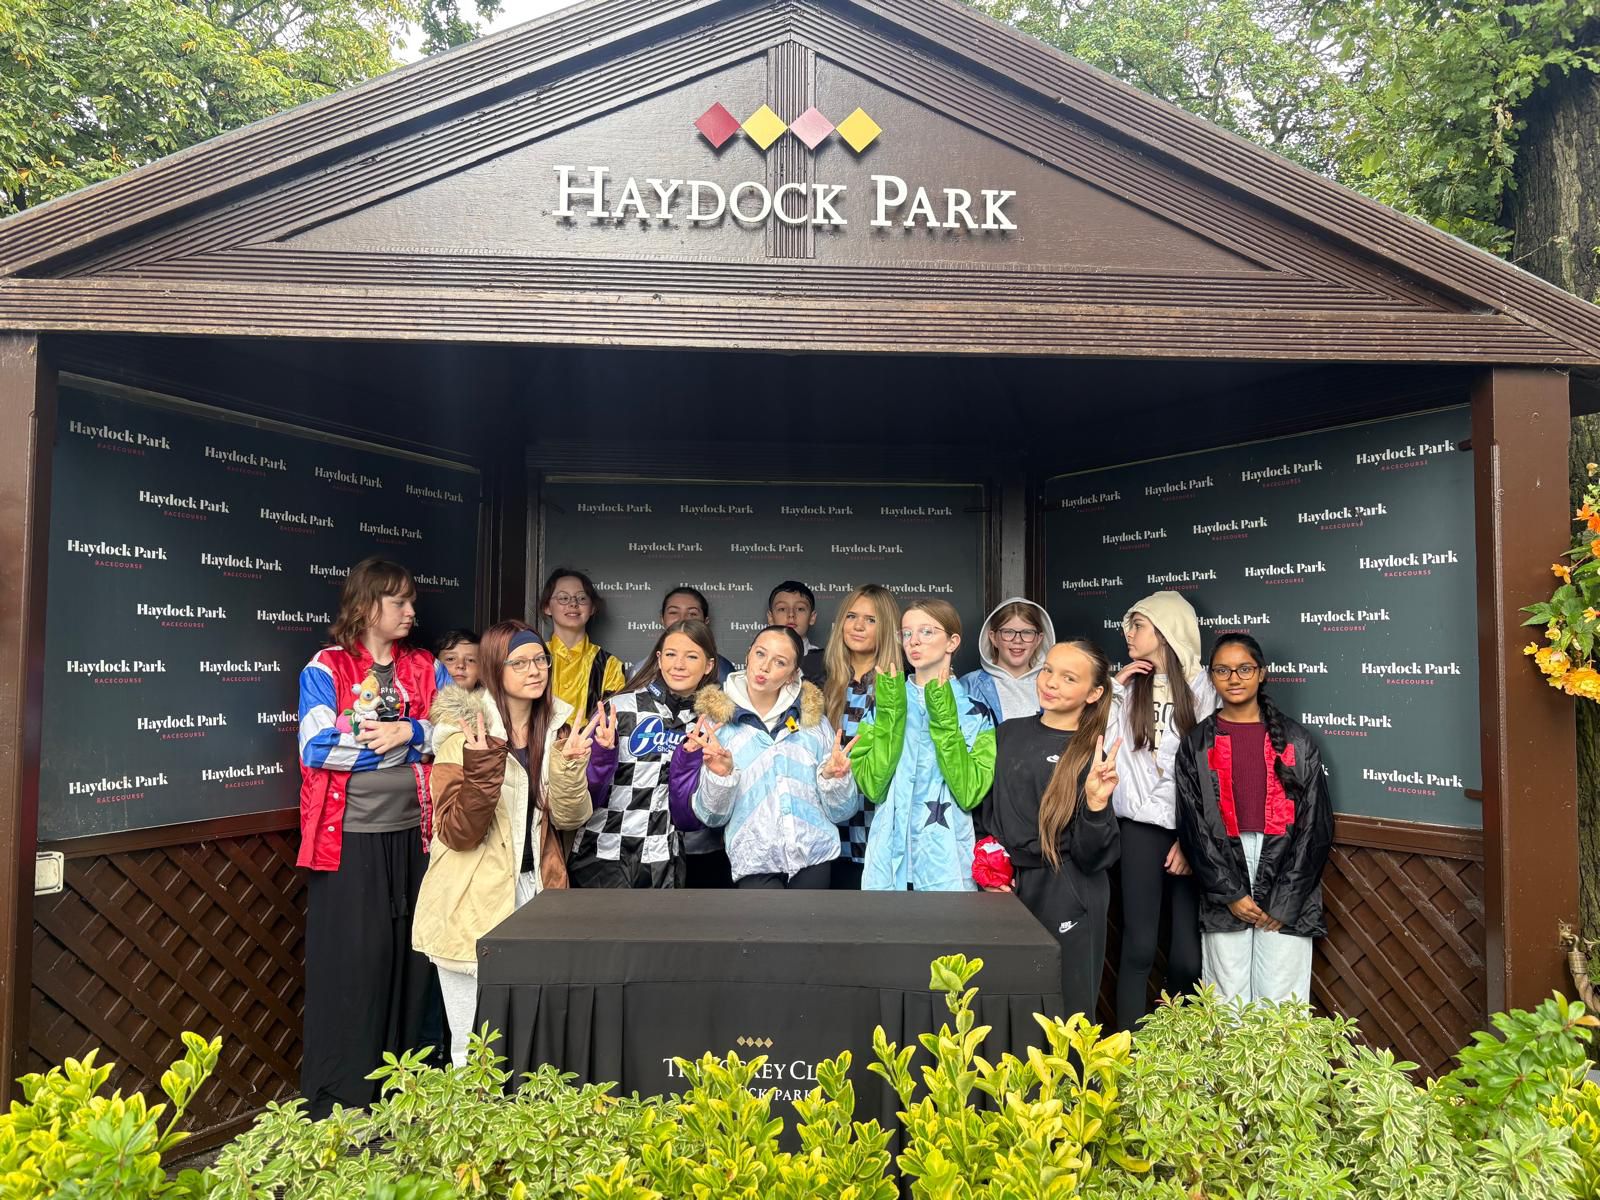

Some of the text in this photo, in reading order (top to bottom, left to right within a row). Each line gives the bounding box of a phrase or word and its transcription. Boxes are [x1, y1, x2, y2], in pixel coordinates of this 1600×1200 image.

[552, 164, 1018, 231] HAYDOCK PARK
[70, 421, 170, 449] Haydock Park
[205, 446, 286, 470] Haydock Park
[1357, 440, 1454, 466] Haydock Park
[1242, 460, 1322, 483] Haydock Park
[1381, 459, 1429, 471] RACECOURSE
[315, 467, 382, 488] Haydock Park
[406, 484, 442, 500] Haydock
[444, 492, 463, 502] Park
[1145, 476, 1213, 497] Haydock Park
[140, 491, 229, 513] Haydock Park
[1062, 491, 1120, 508] Haydock Park
[164, 510, 207, 520] RACECOURSE
[578, 504, 652, 514] Haydock Park
[681, 505, 753, 516] Haydock Park
[781, 506, 853, 516] Haydock Park
[881, 507, 952, 517] Haydock Park
[1298, 503, 1387, 525] Haydock Park
[261, 508, 334, 527] Haydock Park
[360, 522, 422, 539] Haydock Park
[1193, 517, 1267, 536] Haydock Park
[1103, 528, 1167, 545] Haydock Park
[68, 540, 167, 560] Haydock Park
[629, 542, 702, 553] Haydock Park
[731, 544, 803, 554] Haydock Park
[832, 544, 876, 555] Haydock
[95, 560, 143, 569] RACECOURSE
[202, 553, 282, 571] Haydock Park
[1360, 550, 1457, 571] Haydock Park
[1148, 569, 1216, 586] Haydock Park
[1245, 561, 1326, 579] Haydock Park
[1384, 569, 1431, 577] RACECOURSE
[440, 577, 459, 586] Park
[592, 582, 651, 591] ydock Park
[729, 583, 753, 591] Park
[929, 584, 953, 592] Park
[1063, 576, 1123, 591] Haydock Park
[137, 604, 226, 619] Haydock Park
[257, 610, 330, 624] Haydock Park
[1244, 613, 1270, 624] Park
[1301, 609, 1390, 626] Haydock Park
[161, 621, 205, 629] RACECOURSE
[628, 621, 664, 632] Haydo
[731, 621, 768, 632] Haydo
[67, 660, 166, 676] Haydock Park
[200, 661, 280, 675] Haydock Park
[1266, 662, 1328, 673] dock Park
[1361, 662, 1461, 678] Haydock Park
[138, 713, 226, 732] Haydock Park
[1302, 713, 1392, 728] Haydock Park
[162, 731, 206, 740] RACECOURSE
[1324, 729, 1368, 737] RACECOURSE
[202, 762, 283, 782] Haydock Park
[1363, 769, 1462, 787] Haydock Park
[69, 773, 168, 797] Haydock Park
[225, 779, 264, 789] RACECOURSE
[1388, 786, 1436, 796] RACECOURSE
[96, 793, 144, 804] RACECOURSE
[789, 1060, 817, 1080] CL
